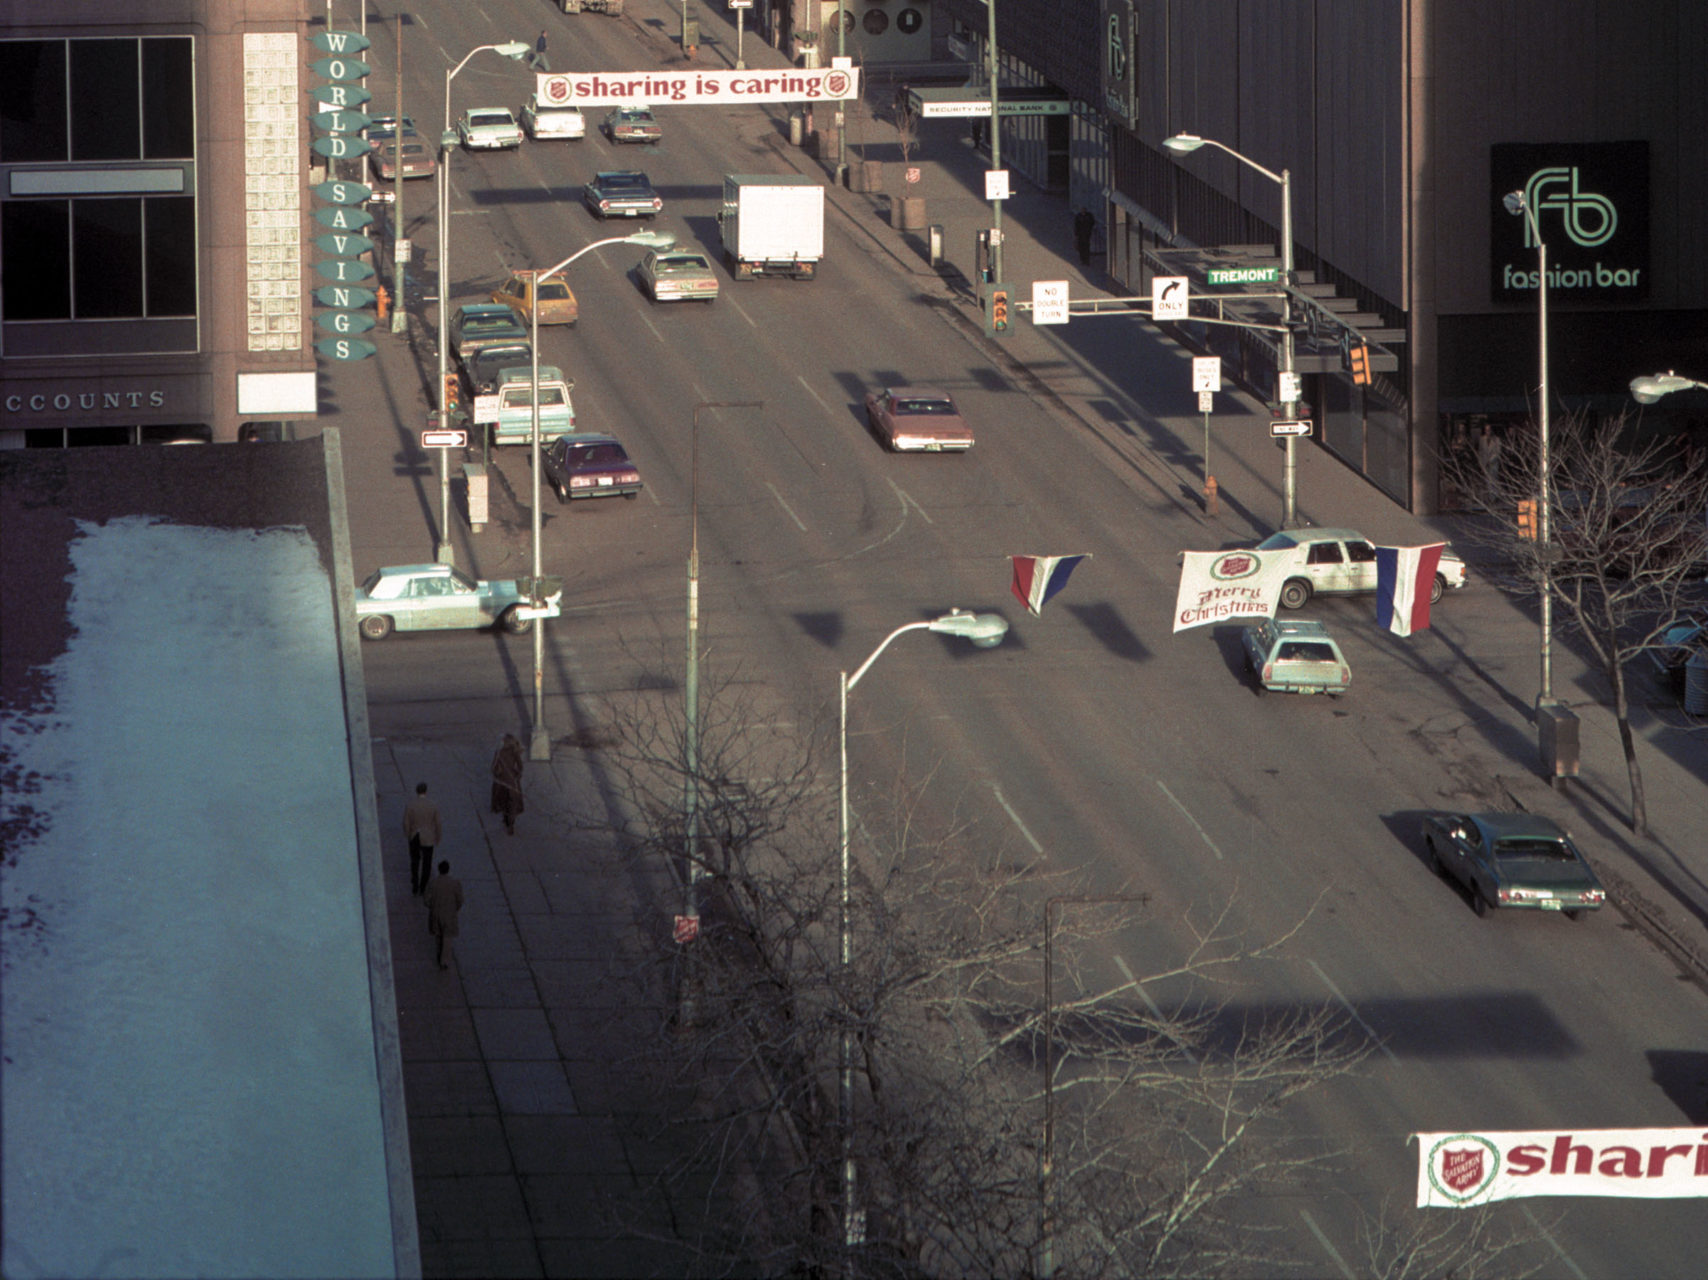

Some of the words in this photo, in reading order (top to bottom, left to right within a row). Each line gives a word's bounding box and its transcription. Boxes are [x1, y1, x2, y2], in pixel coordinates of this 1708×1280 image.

[326, 33, 348, 156] WORLD
[575, 76, 686, 100] sharing
[696, 74, 719, 94] is
[729, 73, 822, 97] caring
[332, 184, 352, 360] SAVINGS
[1211, 268, 1275, 283] TREMONT
[1504, 263, 1593, 289] fashion
[1596, 262, 1641, 287] bar
[1044, 287, 1057, 296] NO
[1037, 300, 1064, 308] DOUBLE
[1158, 302, 1184, 311] ONLY
[1041, 311, 1062, 319] TURN
[5, 390, 165, 412] CCOUNTS
[1199, 586, 1261, 606] Merry
[1180, 600, 1268, 624] Christmas
[1450, 1153, 1466, 1167] THE
[1456, 1169, 1477, 1187] ARMY
